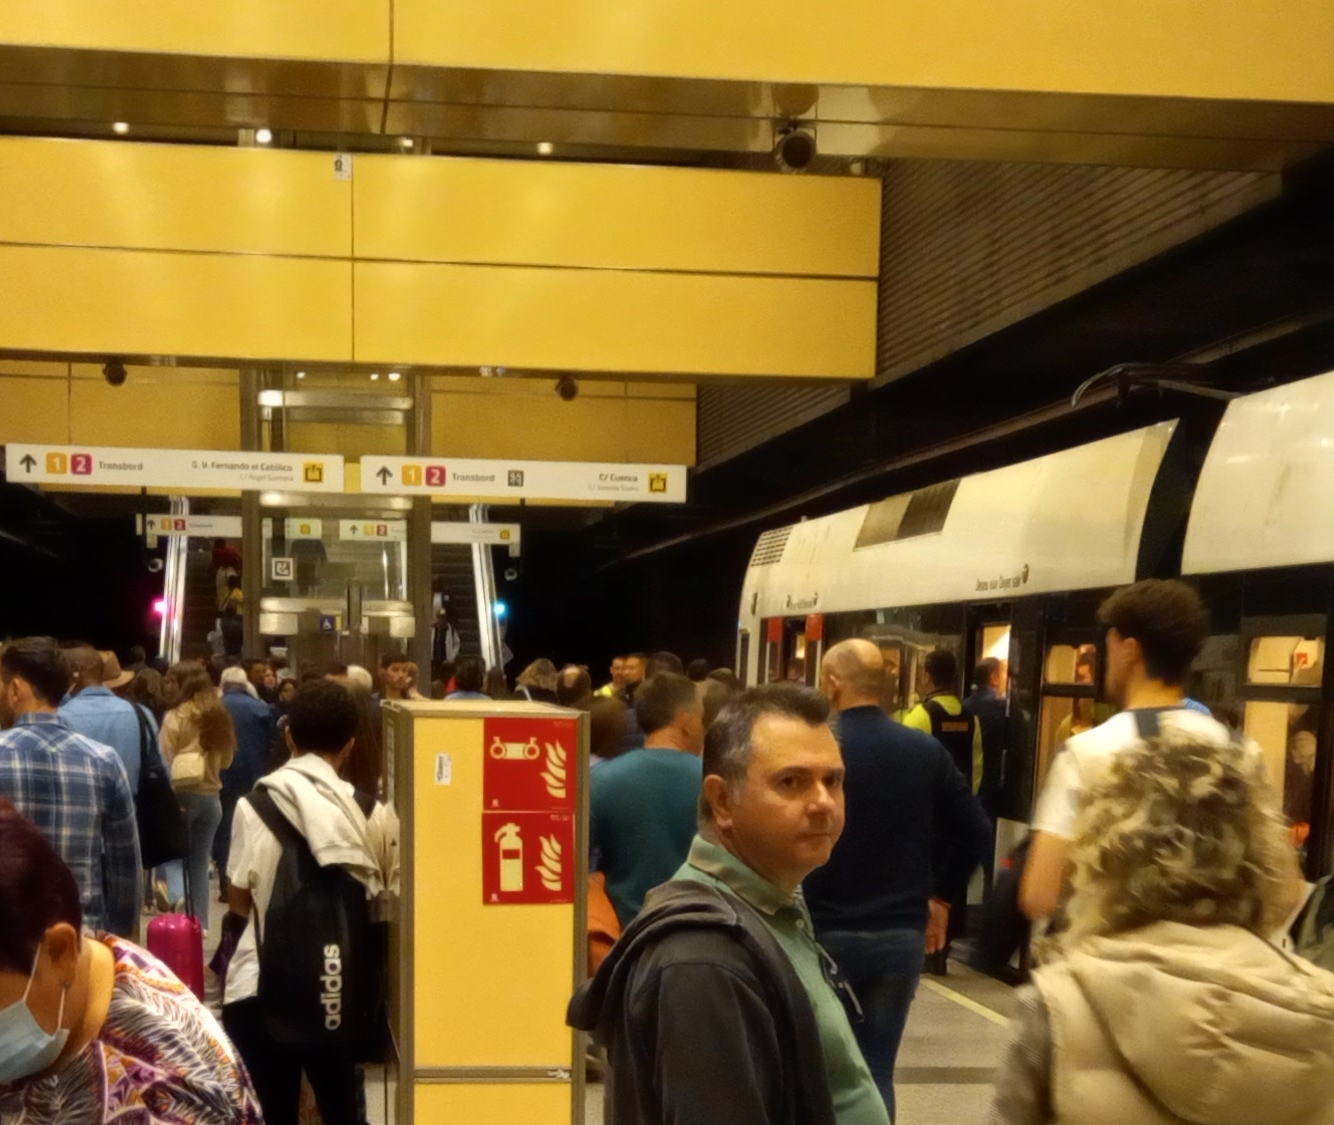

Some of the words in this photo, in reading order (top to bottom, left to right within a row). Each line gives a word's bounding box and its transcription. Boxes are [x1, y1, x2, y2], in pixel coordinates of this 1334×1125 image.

[52, 457, 61, 471] 1
[76, 456, 87, 473] 2
[99, 461, 143, 471] Transbord
[211, 461, 250, 472] Fernando
[408, 469, 416, 482] 1
[430, 468, 441, 484] 2
[452, 473, 495, 482] Transbord
[320, 944, 342, 1030] adidas
